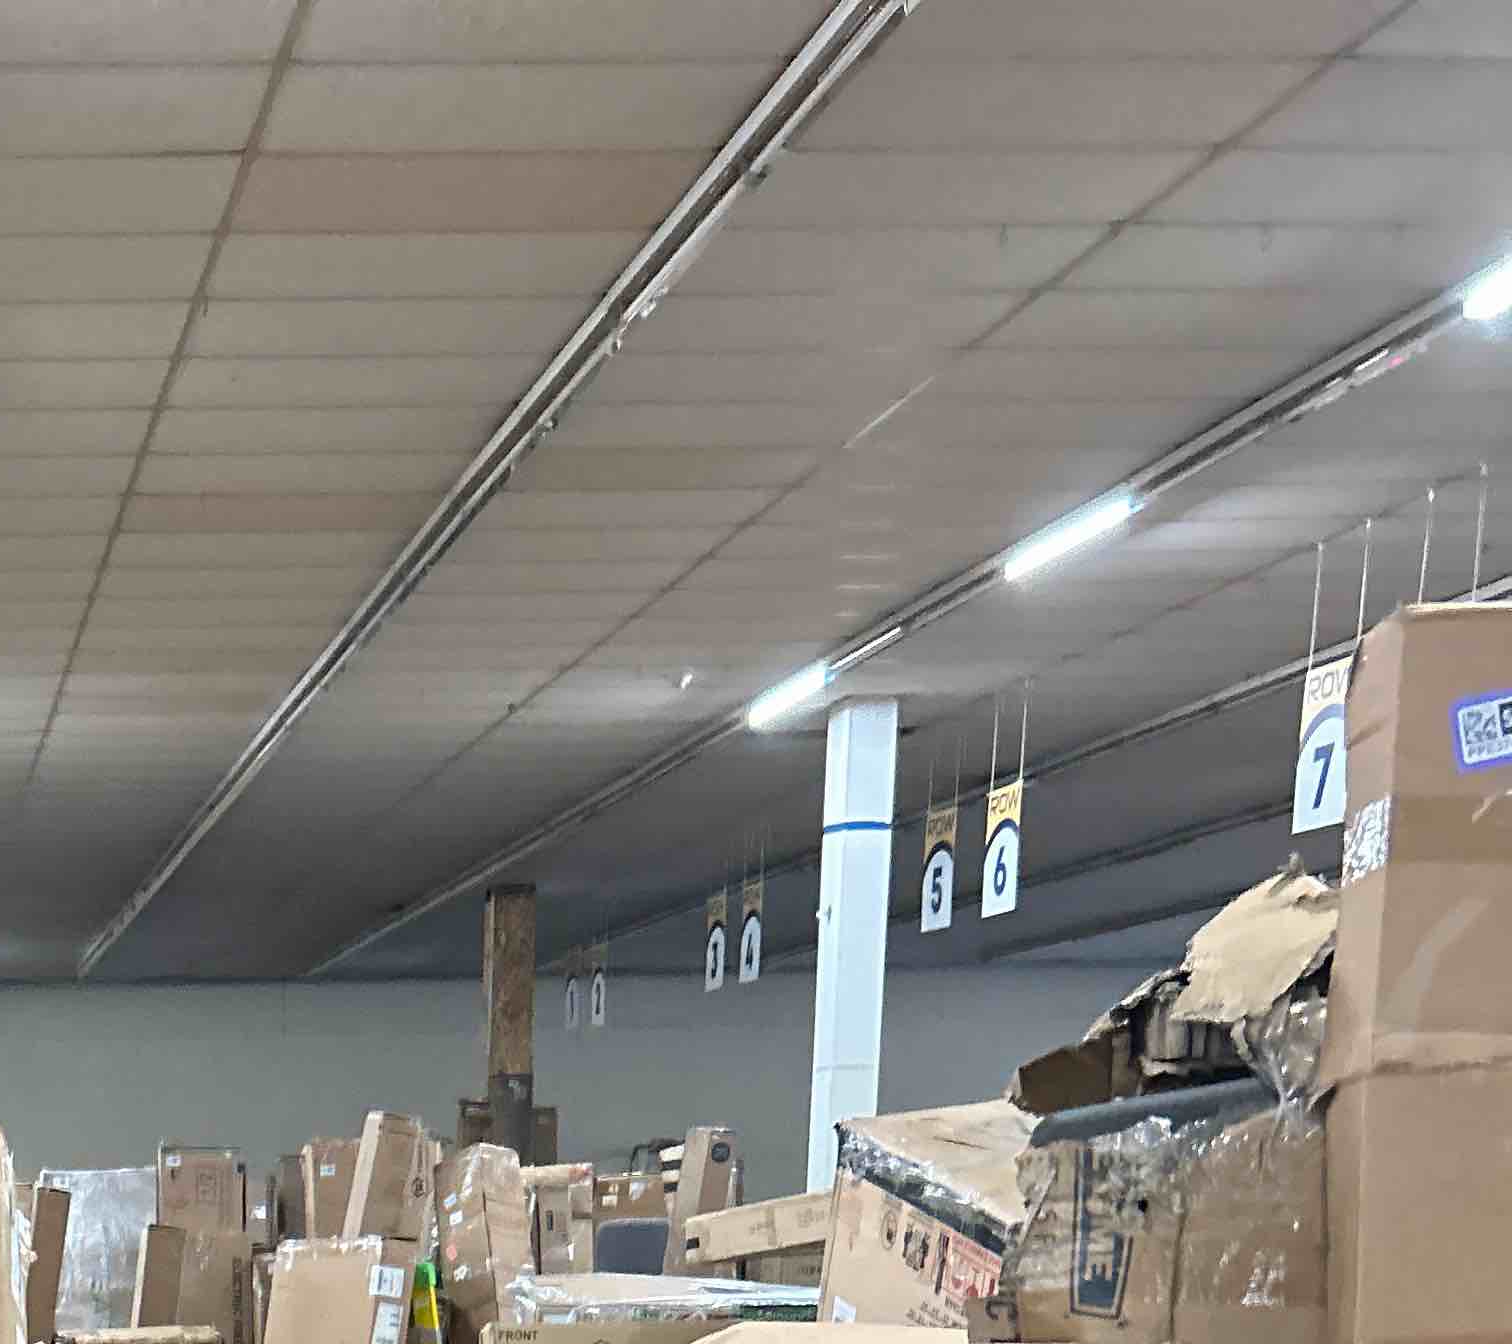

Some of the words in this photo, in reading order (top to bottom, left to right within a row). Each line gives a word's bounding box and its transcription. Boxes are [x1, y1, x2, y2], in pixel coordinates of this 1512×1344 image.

[1312, 741, 1335, 809] 7
[990, 789, 1019, 816] ROW
[931, 866, 942, 914] 5
[994, 846, 1007, 896] 6
[497, 1328, 539, 1343] FRONT
